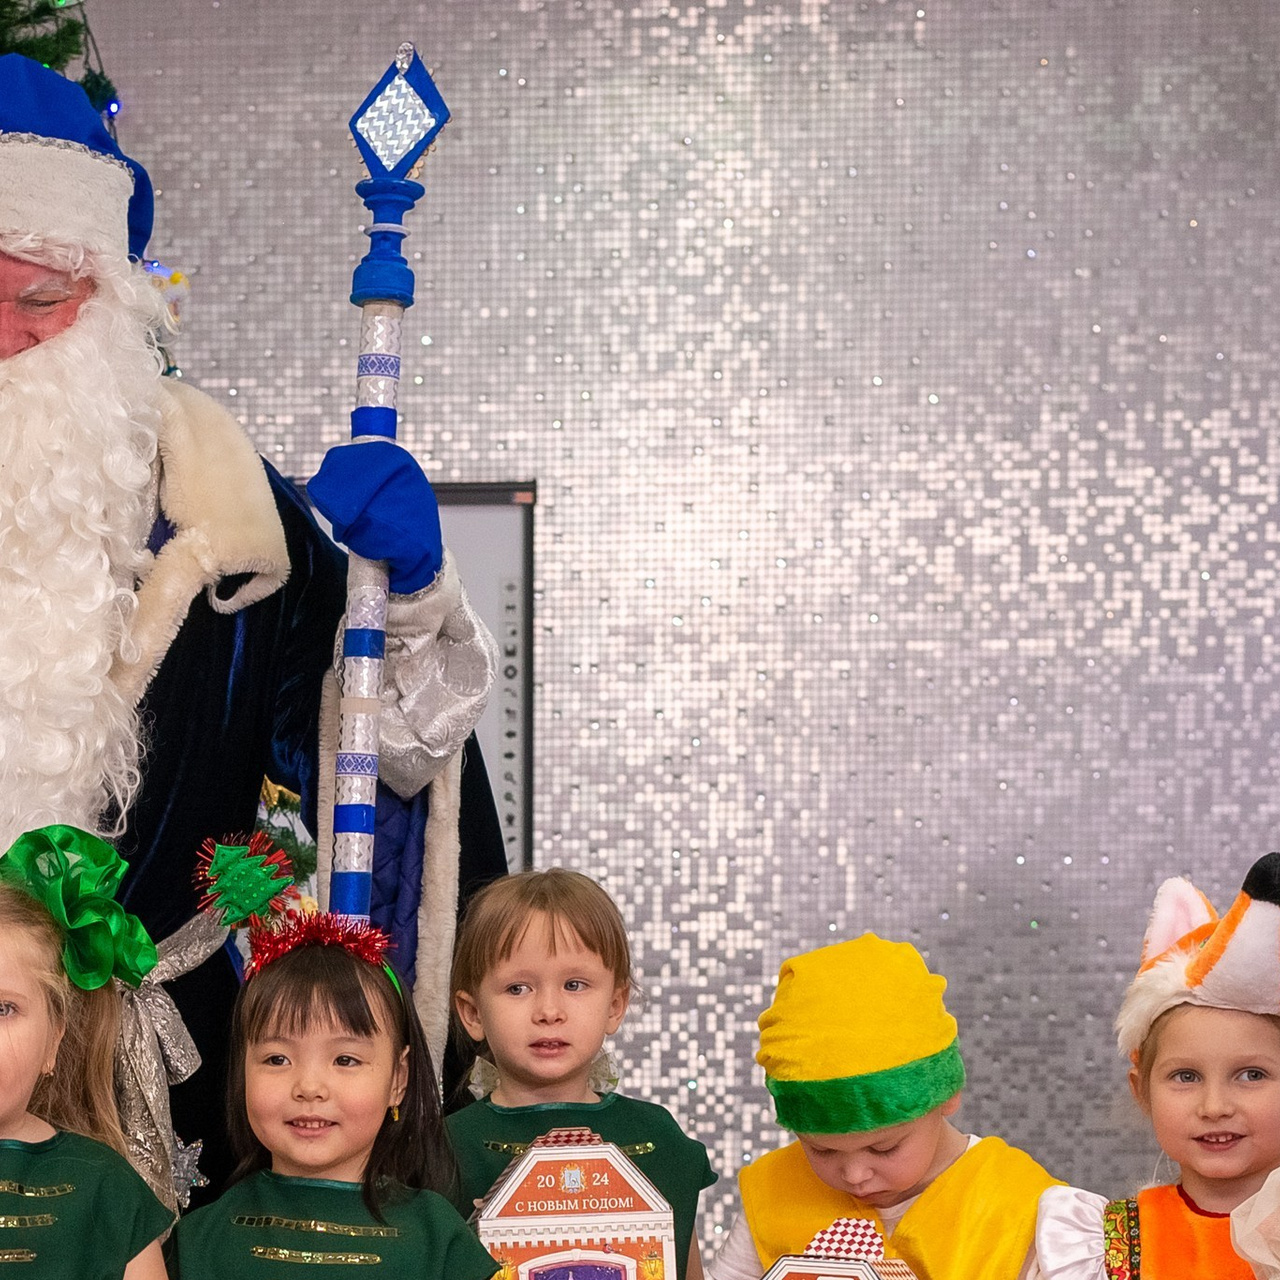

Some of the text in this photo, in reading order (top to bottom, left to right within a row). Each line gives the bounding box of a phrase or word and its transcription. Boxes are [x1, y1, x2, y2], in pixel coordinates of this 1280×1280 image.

[537, 1172, 609, 1188] 20 24
[515, 1197, 634, 1212] С НОВЫМ ГОДОМ!
